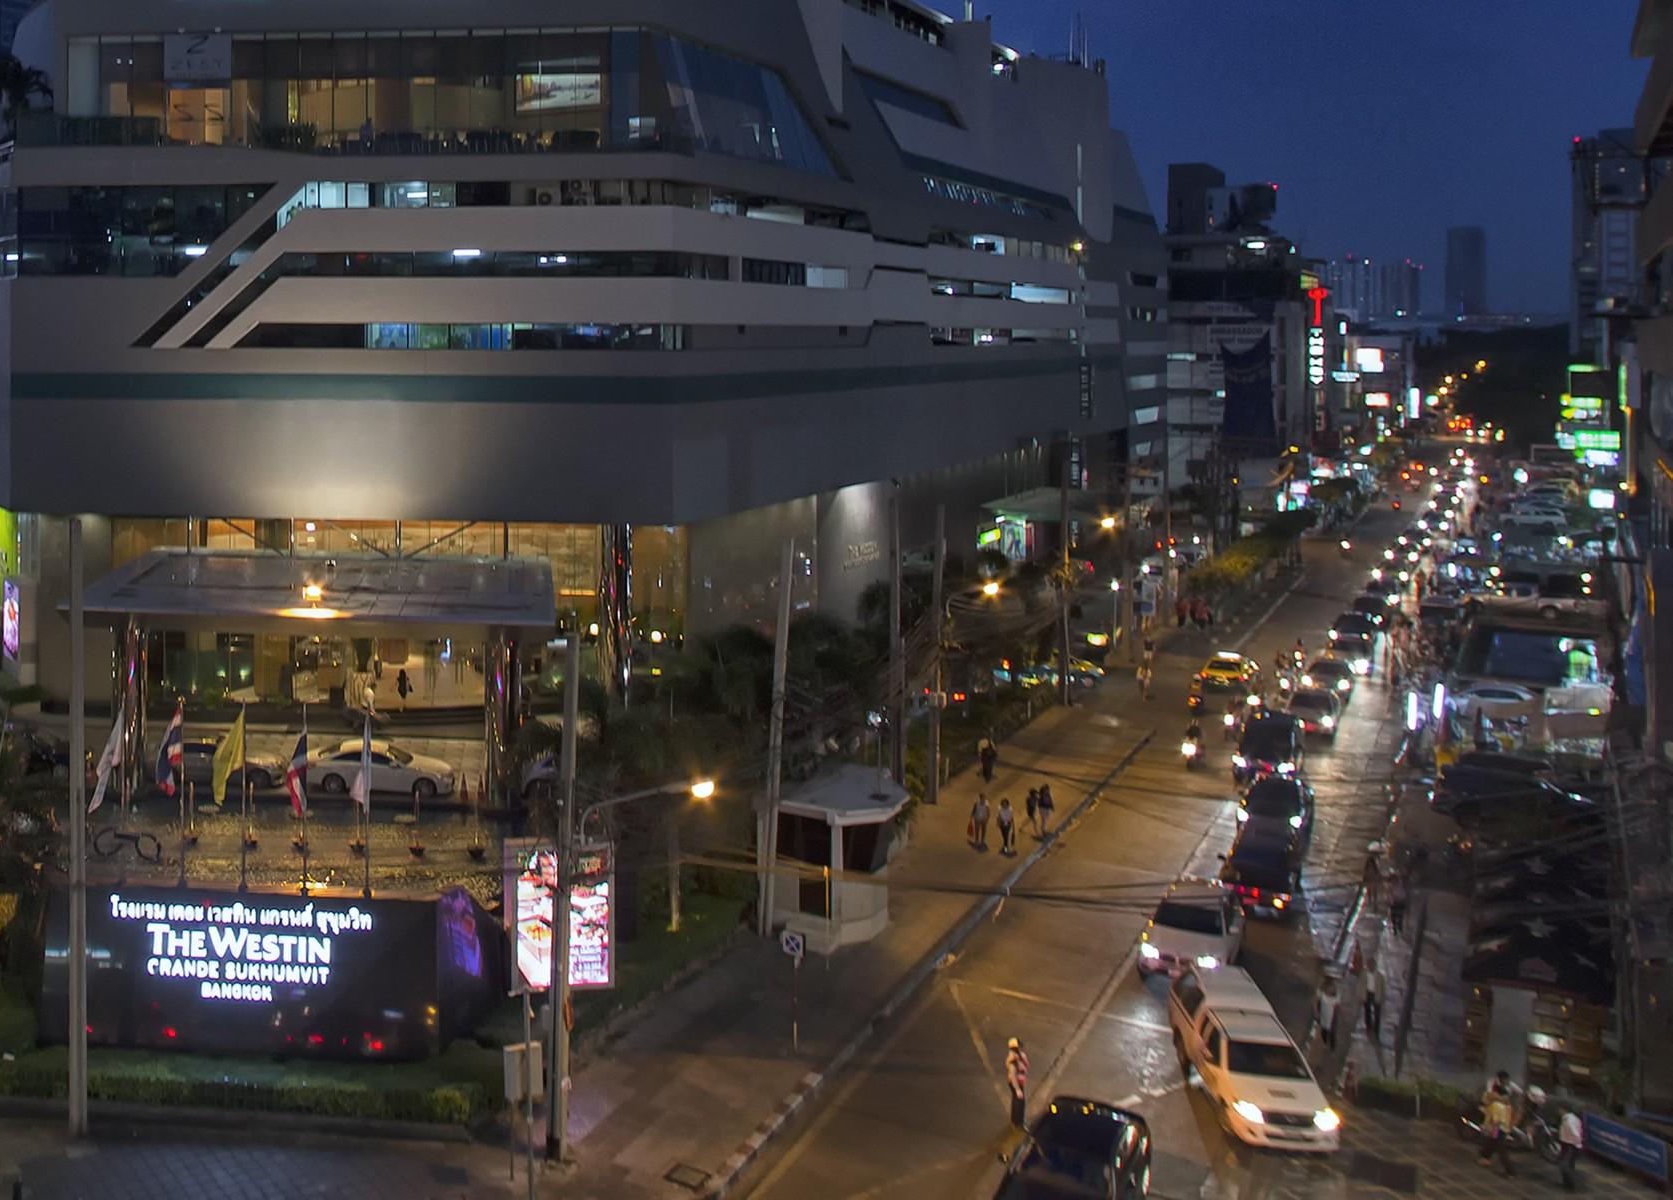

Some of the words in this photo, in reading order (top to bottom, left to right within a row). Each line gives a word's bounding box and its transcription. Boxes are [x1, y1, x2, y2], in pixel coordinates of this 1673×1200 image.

[147, 923, 208, 957] THE
[208, 926, 331, 964] WESTIN
[147, 958, 220, 979] GRANDE
[224, 961, 330, 985] SUKHUMVIT
[200, 982, 273, 1002] BANGKOK
